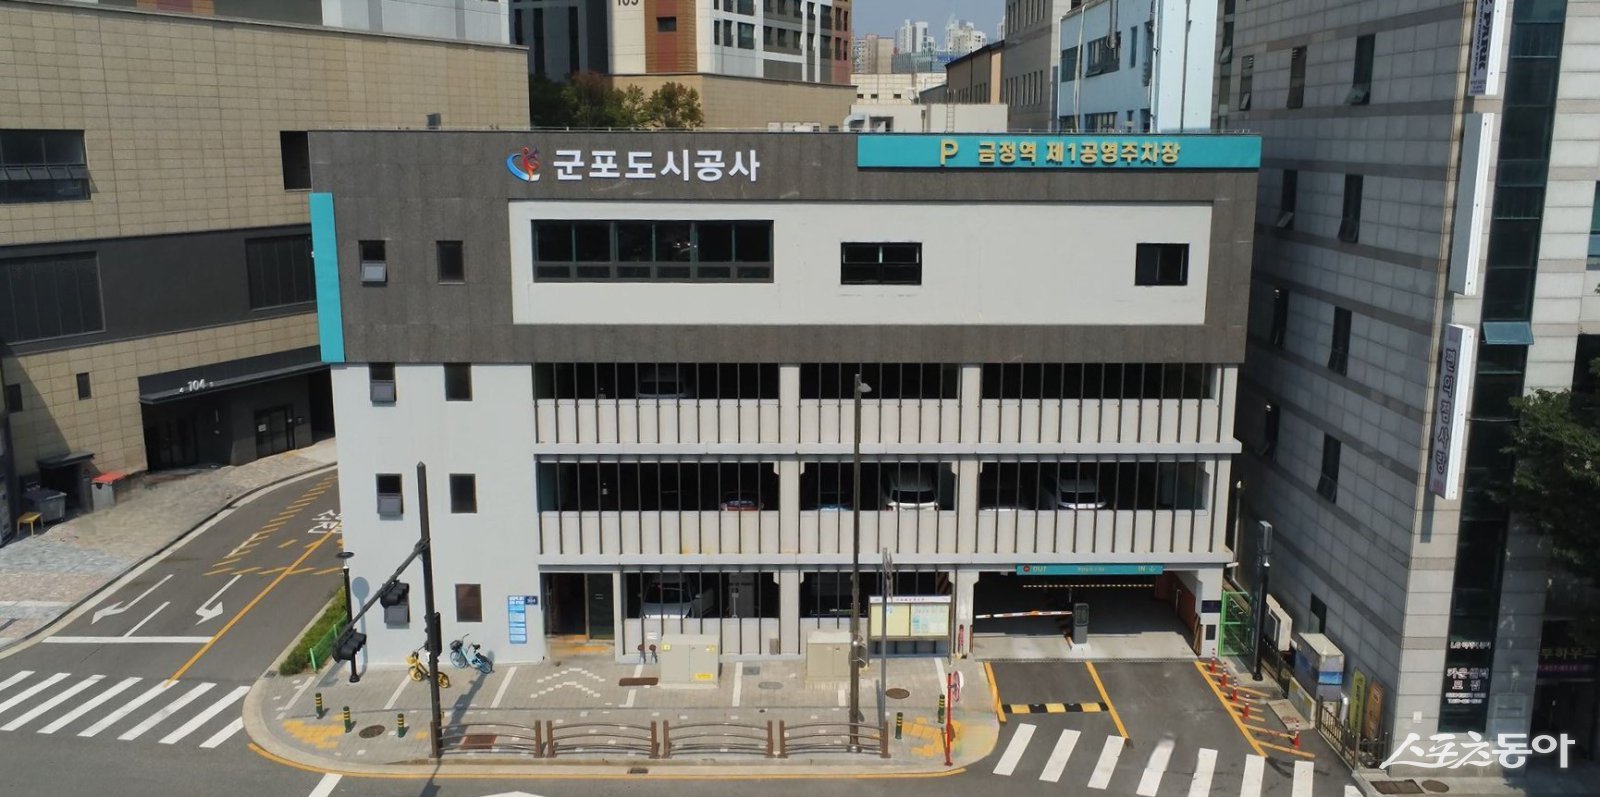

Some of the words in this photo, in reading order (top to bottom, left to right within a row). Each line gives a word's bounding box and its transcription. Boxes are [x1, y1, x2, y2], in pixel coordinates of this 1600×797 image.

[553, 149, 760, 182] 군포도시공사
[939, 138, 959, 165] P
[977, 141, 1037, 165] 금정역
[1046, 140, 1181, 165] 제1공영주차장
